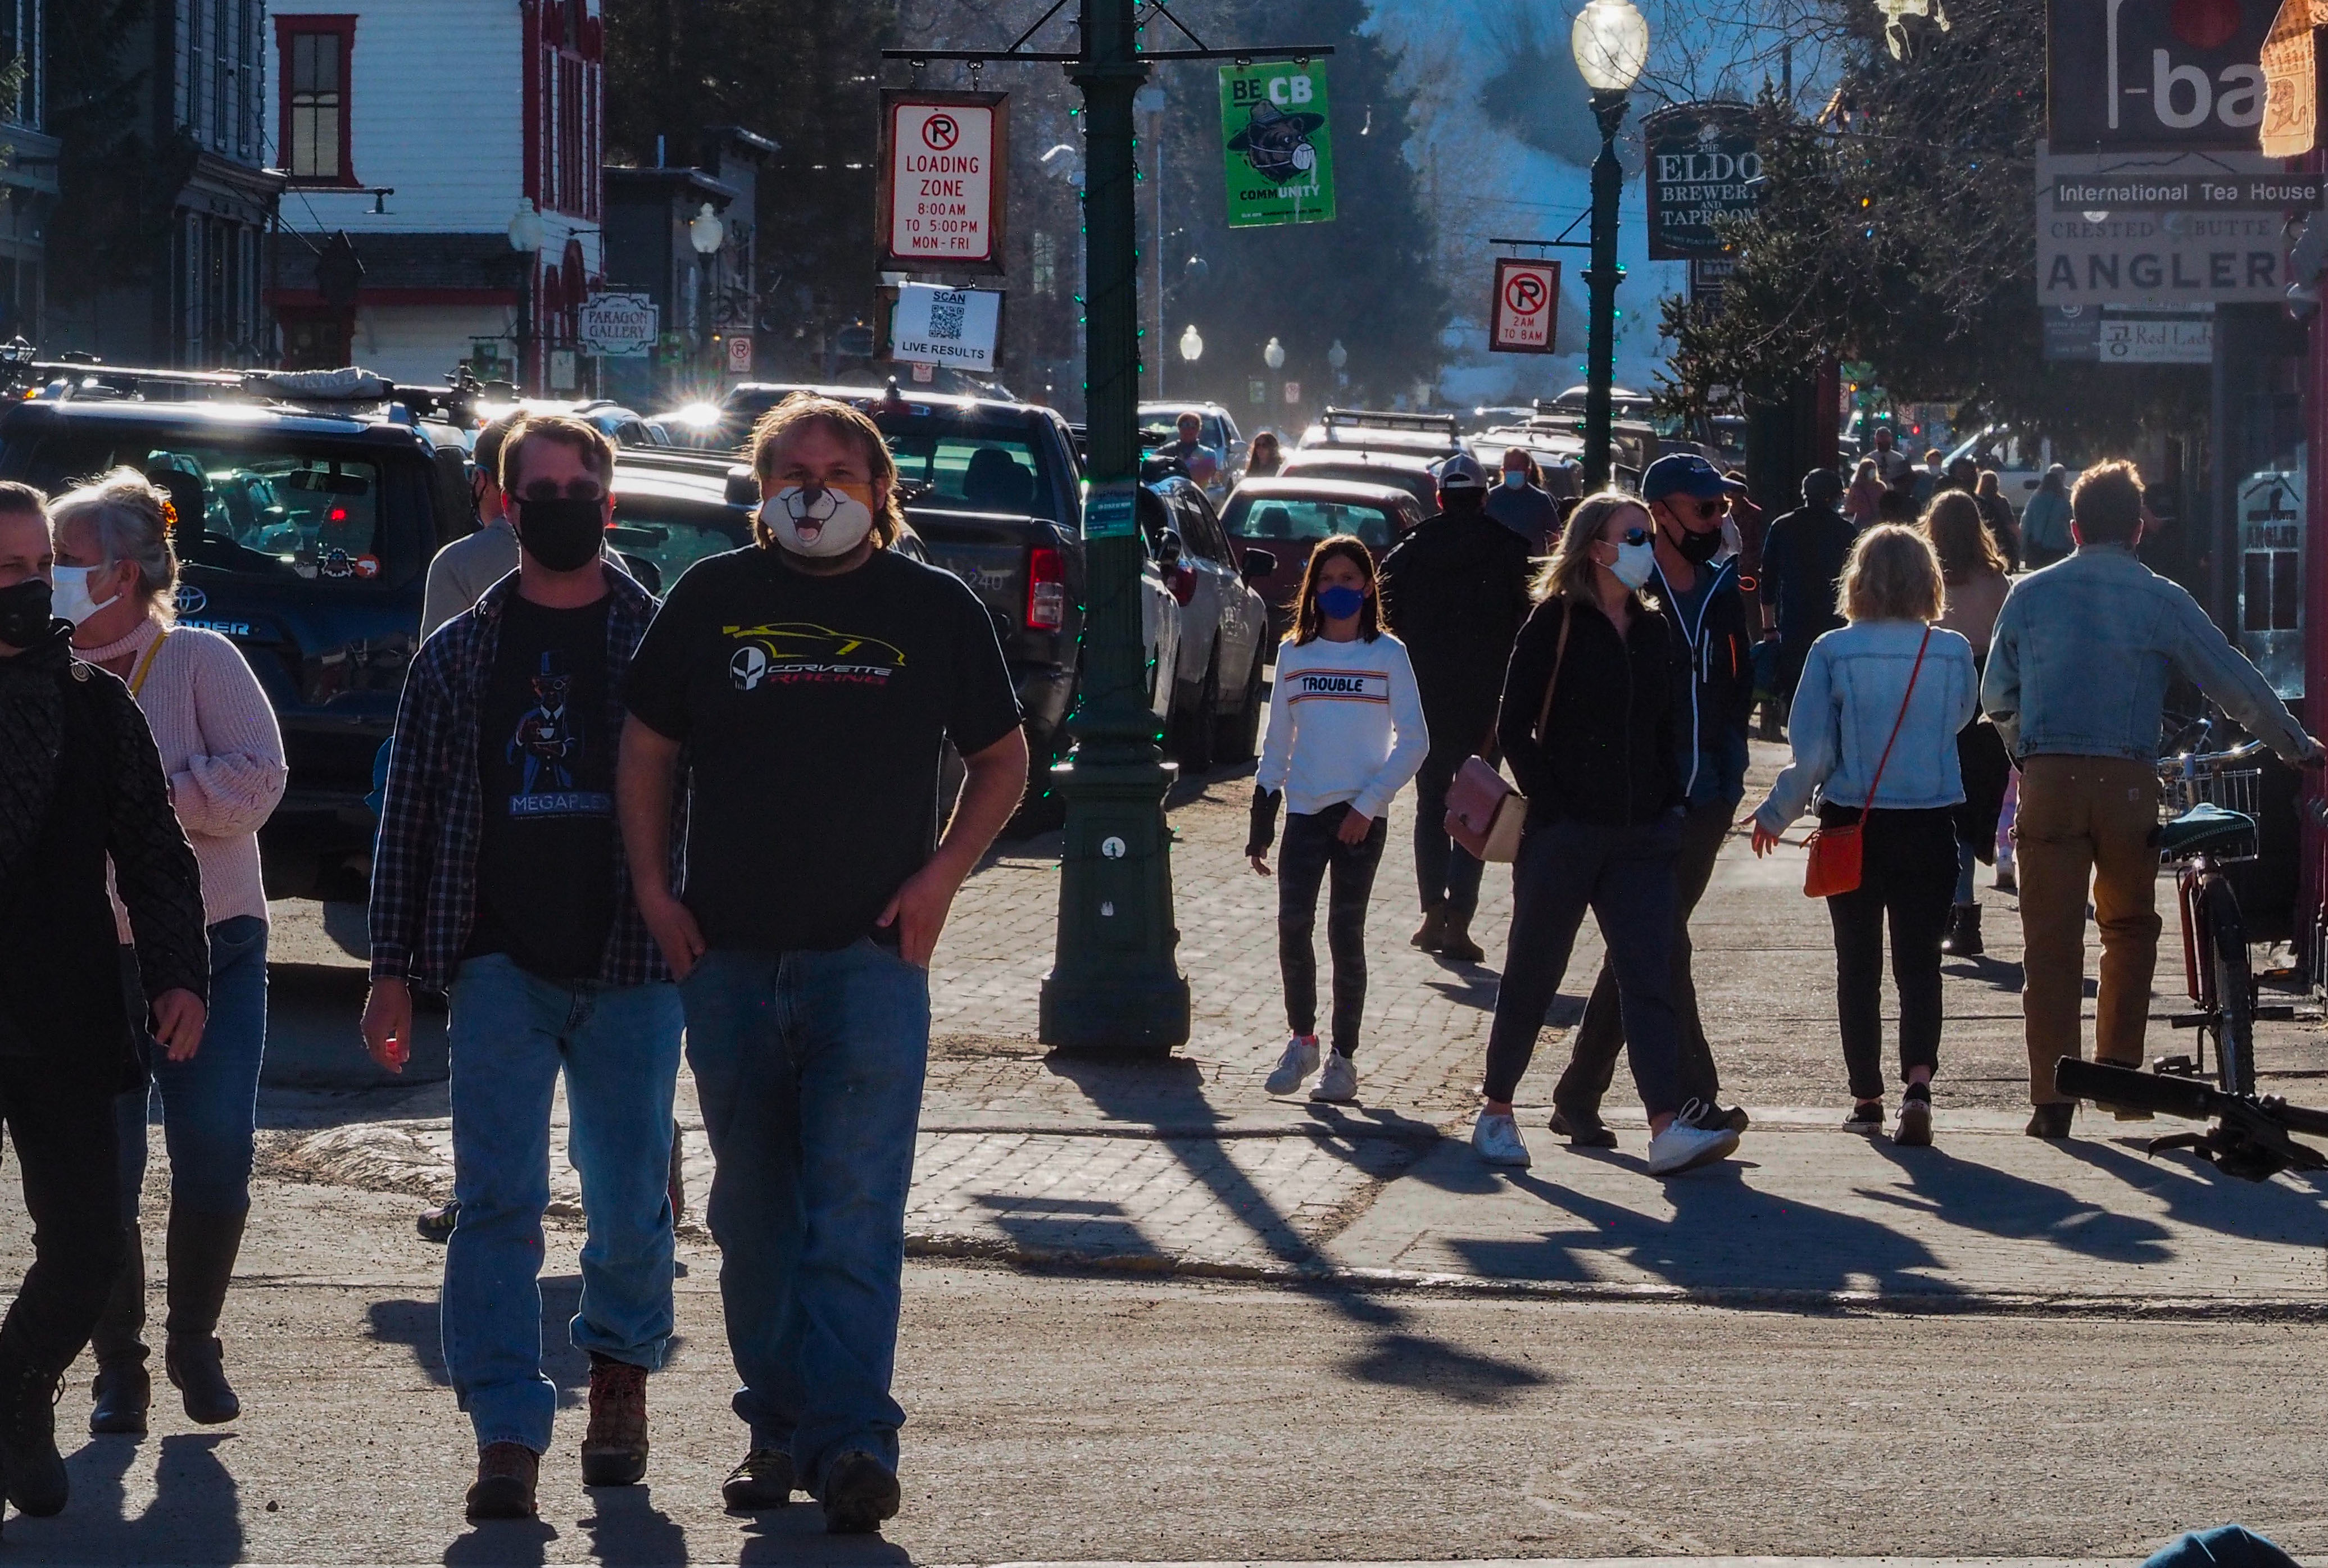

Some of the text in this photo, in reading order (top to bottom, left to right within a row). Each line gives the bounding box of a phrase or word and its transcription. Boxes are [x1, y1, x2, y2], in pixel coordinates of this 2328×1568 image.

[1233, 75, 1313, 105] BE CB
[1698, 144, 1719, 152] THE
[906, 156, 979, 174] LOADING
[1657, 152, 1764, 183] ELDO
[920, 180, 964, 197] ZONE
[1240, 185, 1320, 201] COMMUNITY
[2060, 183, 2316, 201] International Tea House
[918, 203, 965, 215] 8:00 AM
[906, 219, 977, 233] TO 5:00 PM
[2052, 219, 2270, 238] CRESTED BUTTE
[913, 237, 938, 248] MON
[951, 237, 969, 249] FRI
[2046, 252, 2276, 290] ANGLER
[933, 291, 965, 303] SCAN
[589, 311, 647, 324] PARAGON
[1514, 316, 1534, 327] 2AM
[590, 325, 645, 338] GALLERY
[1505, 329, 1542, 340] TO 8AM
[902, 342, 984, 359] LIVE RESULTS
[768, 665, 892, 677] CORVETTE
[1303, 677, 1363, 692] TROUBLE
